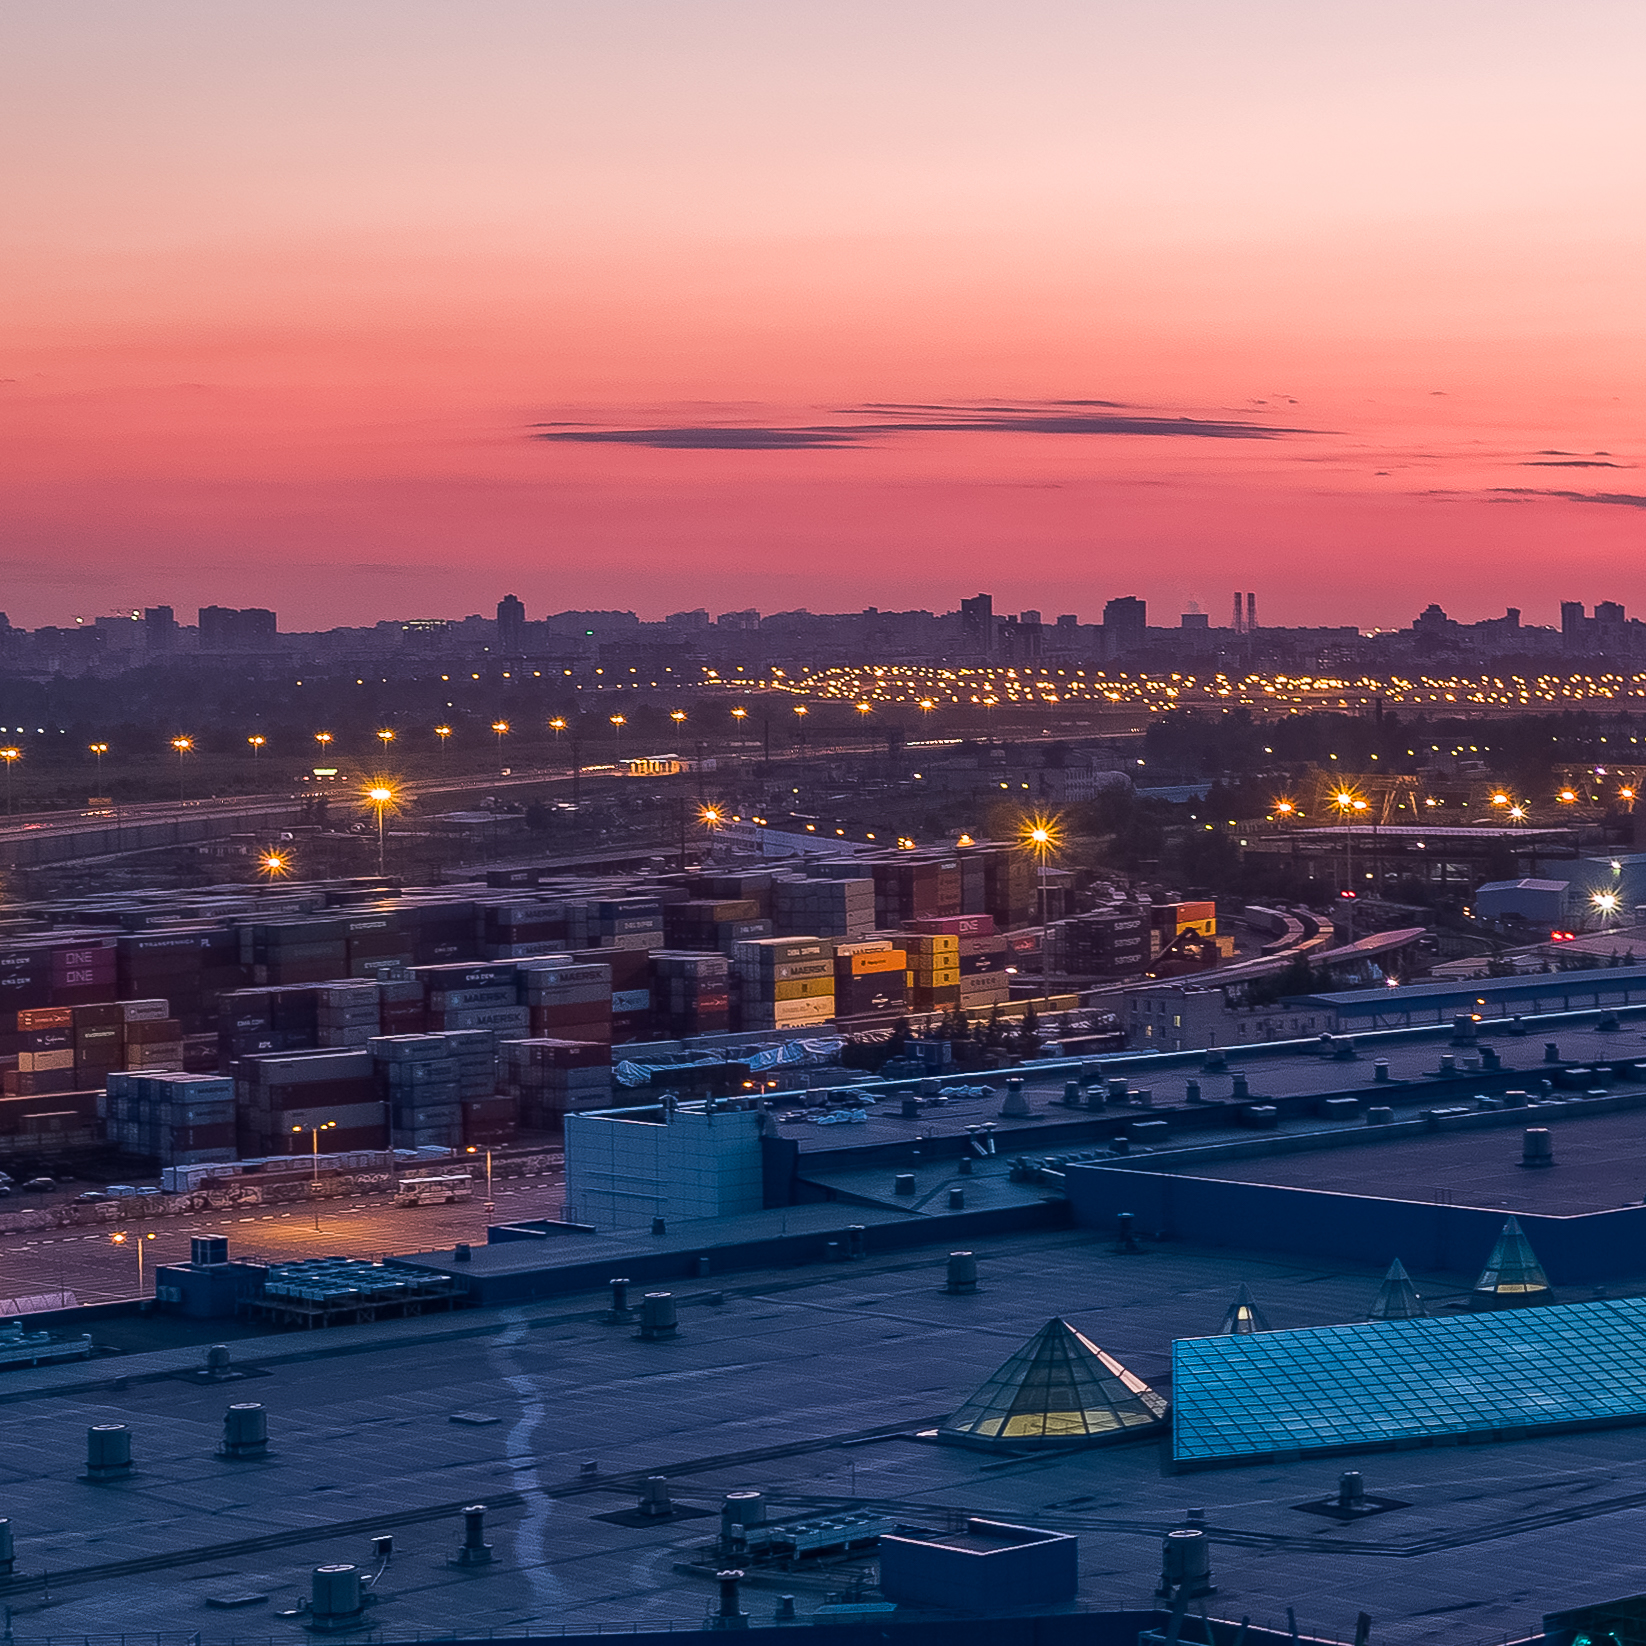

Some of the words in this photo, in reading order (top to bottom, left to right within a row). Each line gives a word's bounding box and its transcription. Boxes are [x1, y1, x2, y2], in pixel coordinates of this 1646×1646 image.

[66, 951, 93, 965] ONE
[791, 964, 827, 975] MAERSK
[66, 970, 93, 983] ONE
[559, 970, 604, 981] MAERSK
[463, 992, 508, 1003] MAERSK
[477, 1013, 522, 1025] MAERSK
